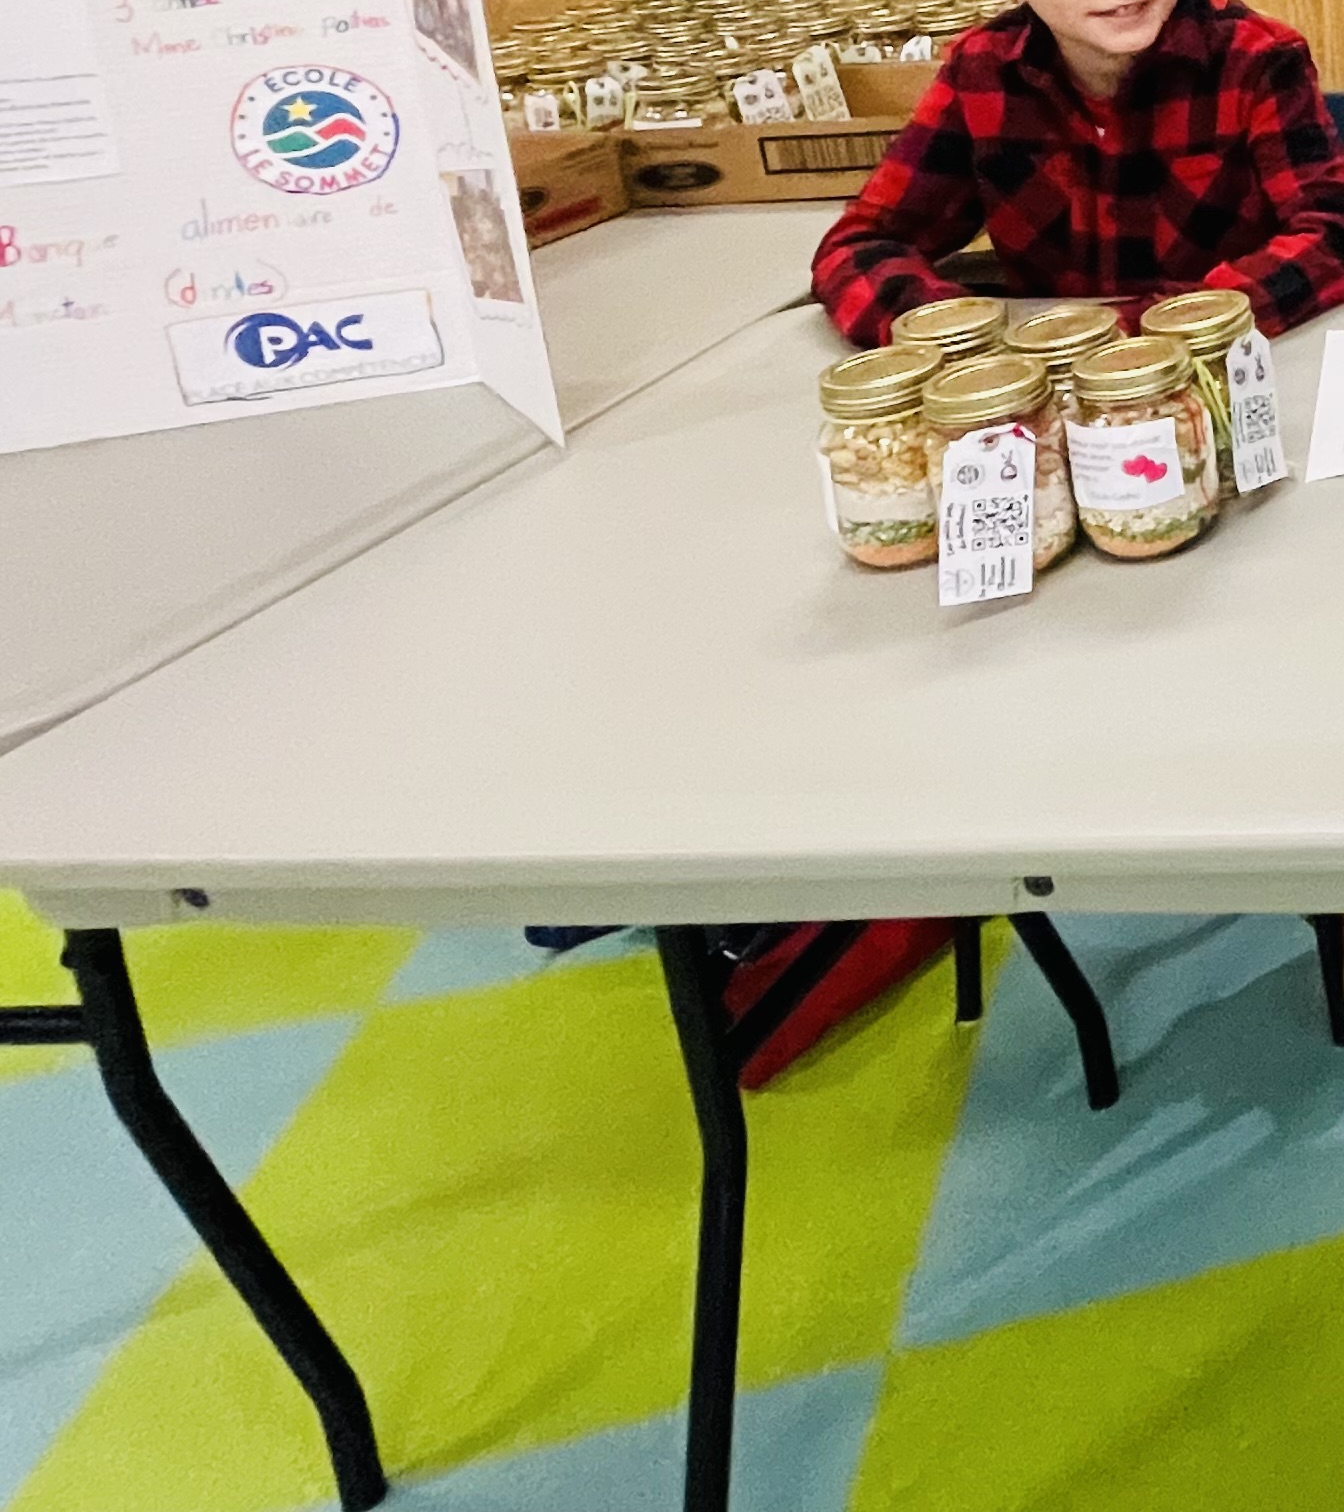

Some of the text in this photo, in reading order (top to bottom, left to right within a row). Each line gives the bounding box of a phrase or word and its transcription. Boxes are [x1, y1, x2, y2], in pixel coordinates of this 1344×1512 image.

[239, 144, 390, 191] LE SOMMET
[369, 196, 398, 217] de
[238, 312, 374, 368] PAC
